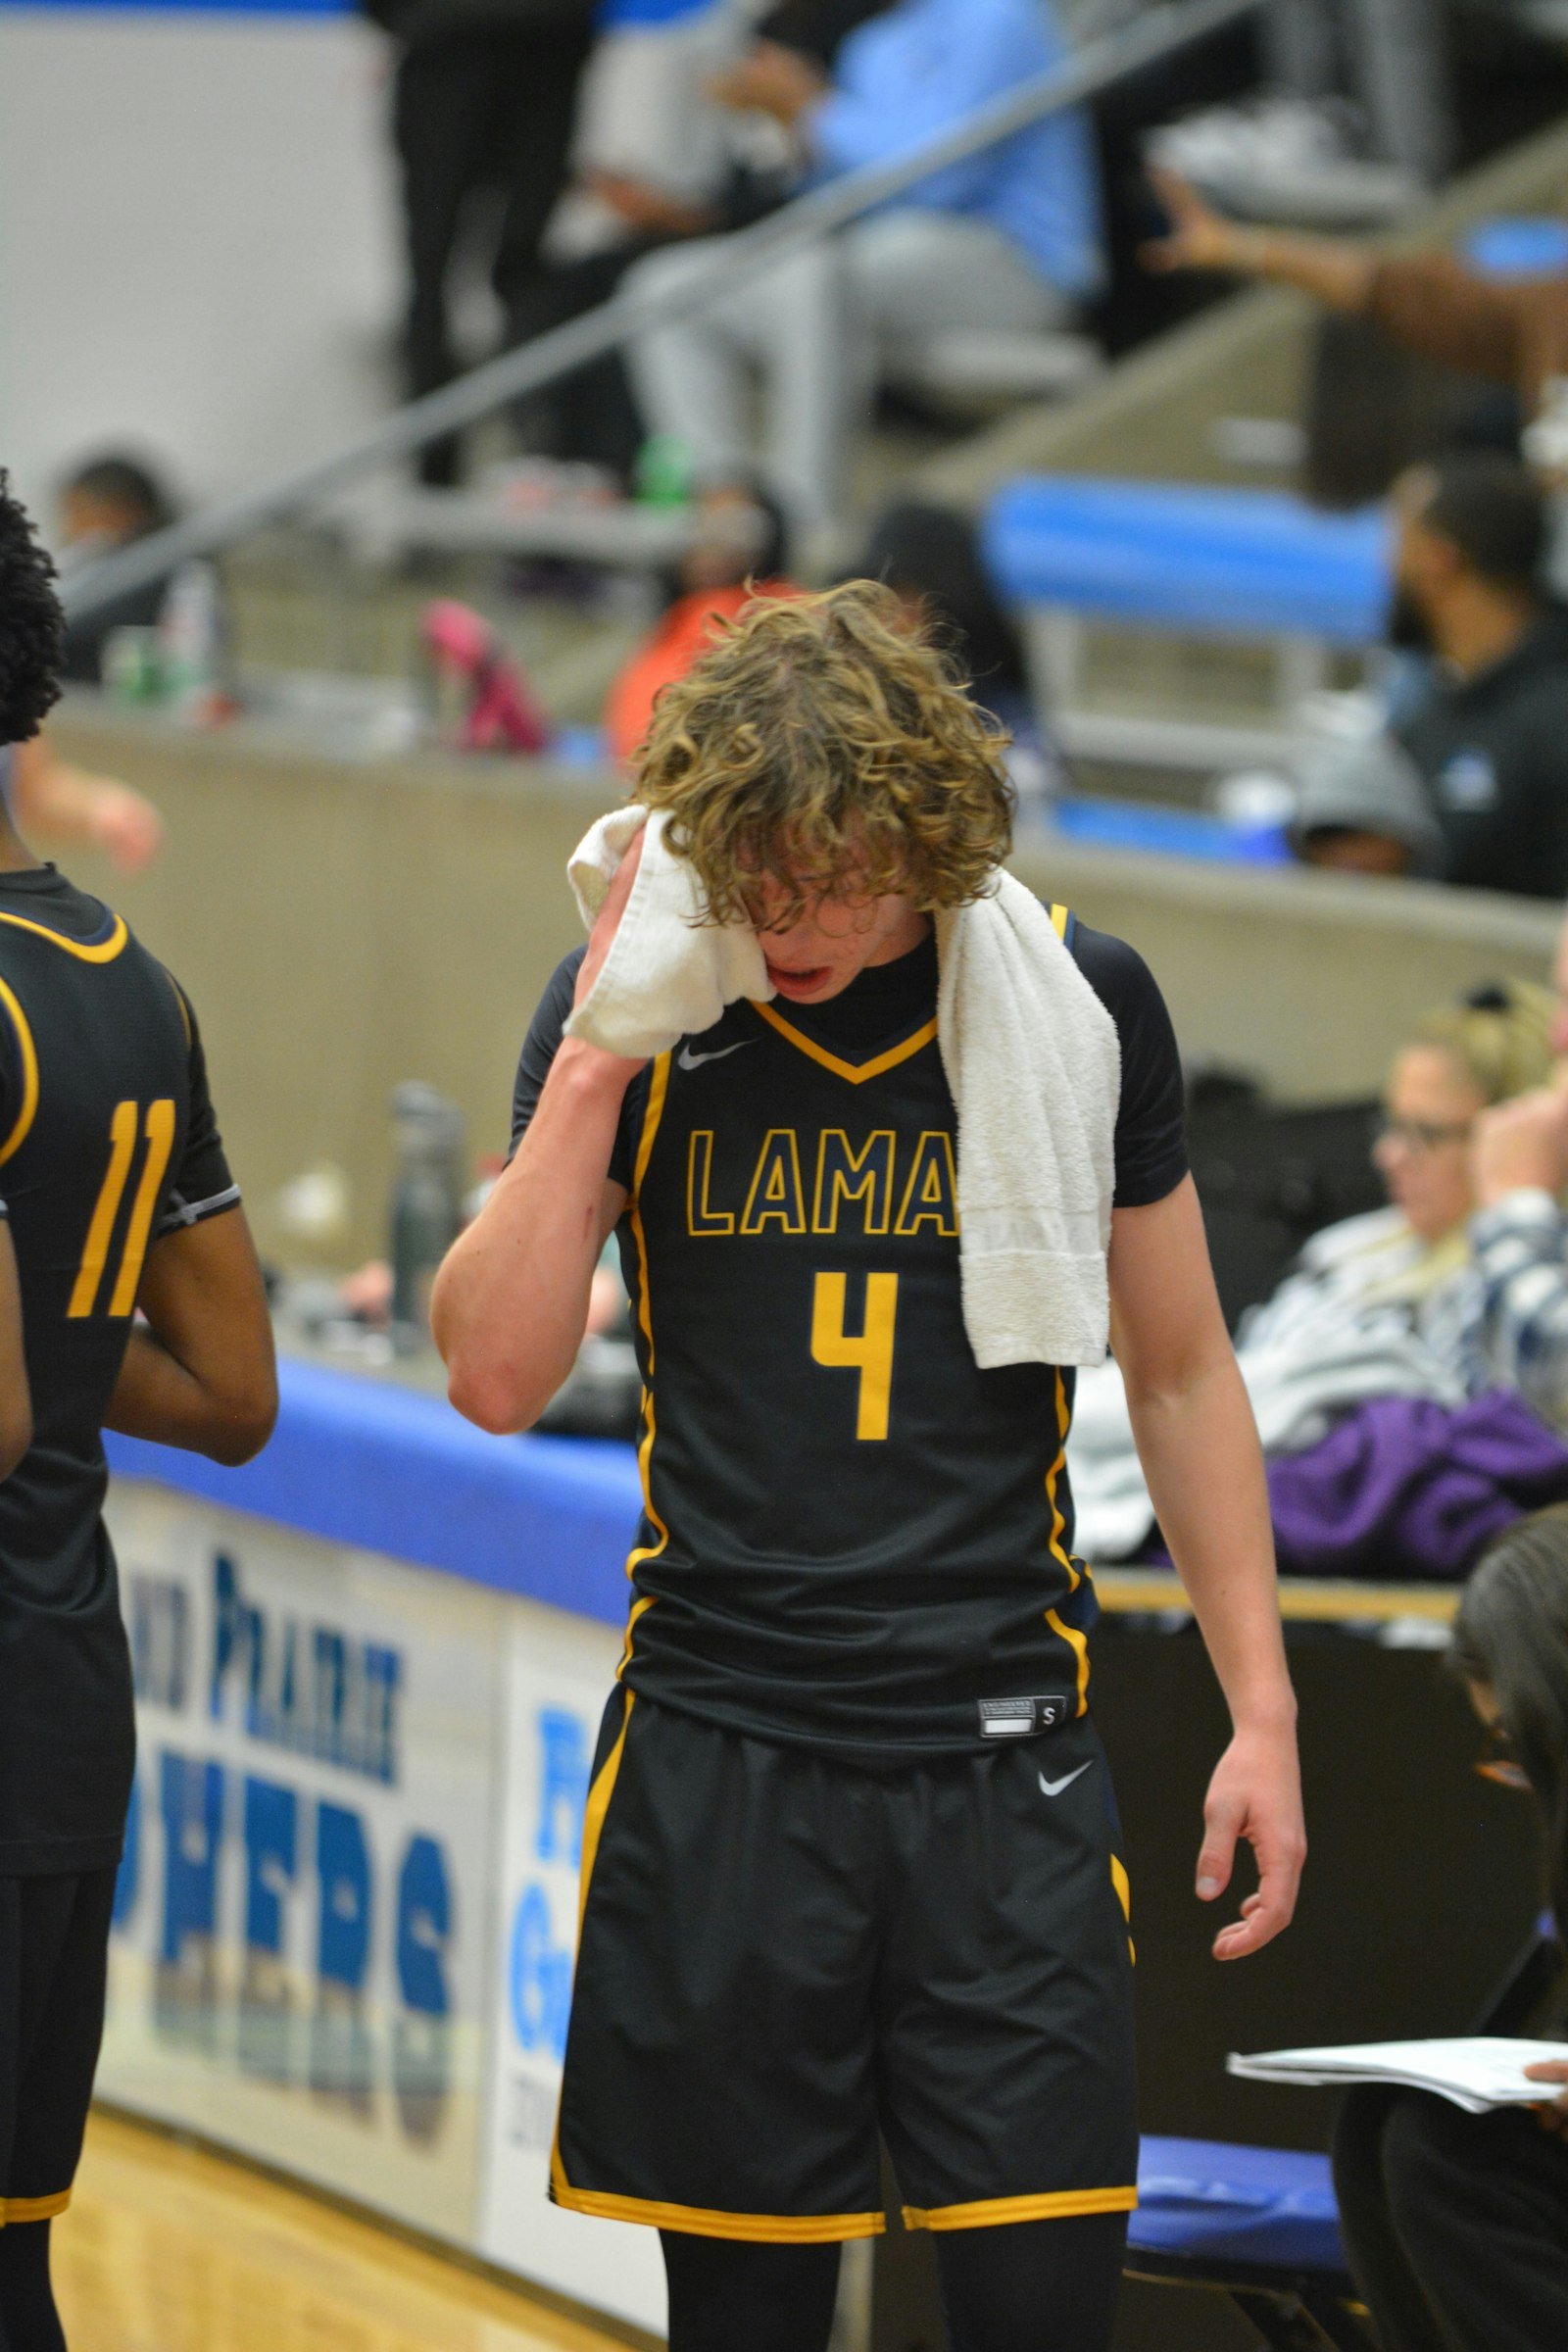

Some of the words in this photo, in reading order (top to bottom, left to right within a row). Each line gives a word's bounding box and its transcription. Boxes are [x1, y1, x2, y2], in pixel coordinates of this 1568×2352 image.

[66, 1100, 175, 1319] 11
[688, 1129, 958, 1237] LAMA
[810, 1272, 900, 1442] 4
[1043, 1707, 1056, 1725] S
